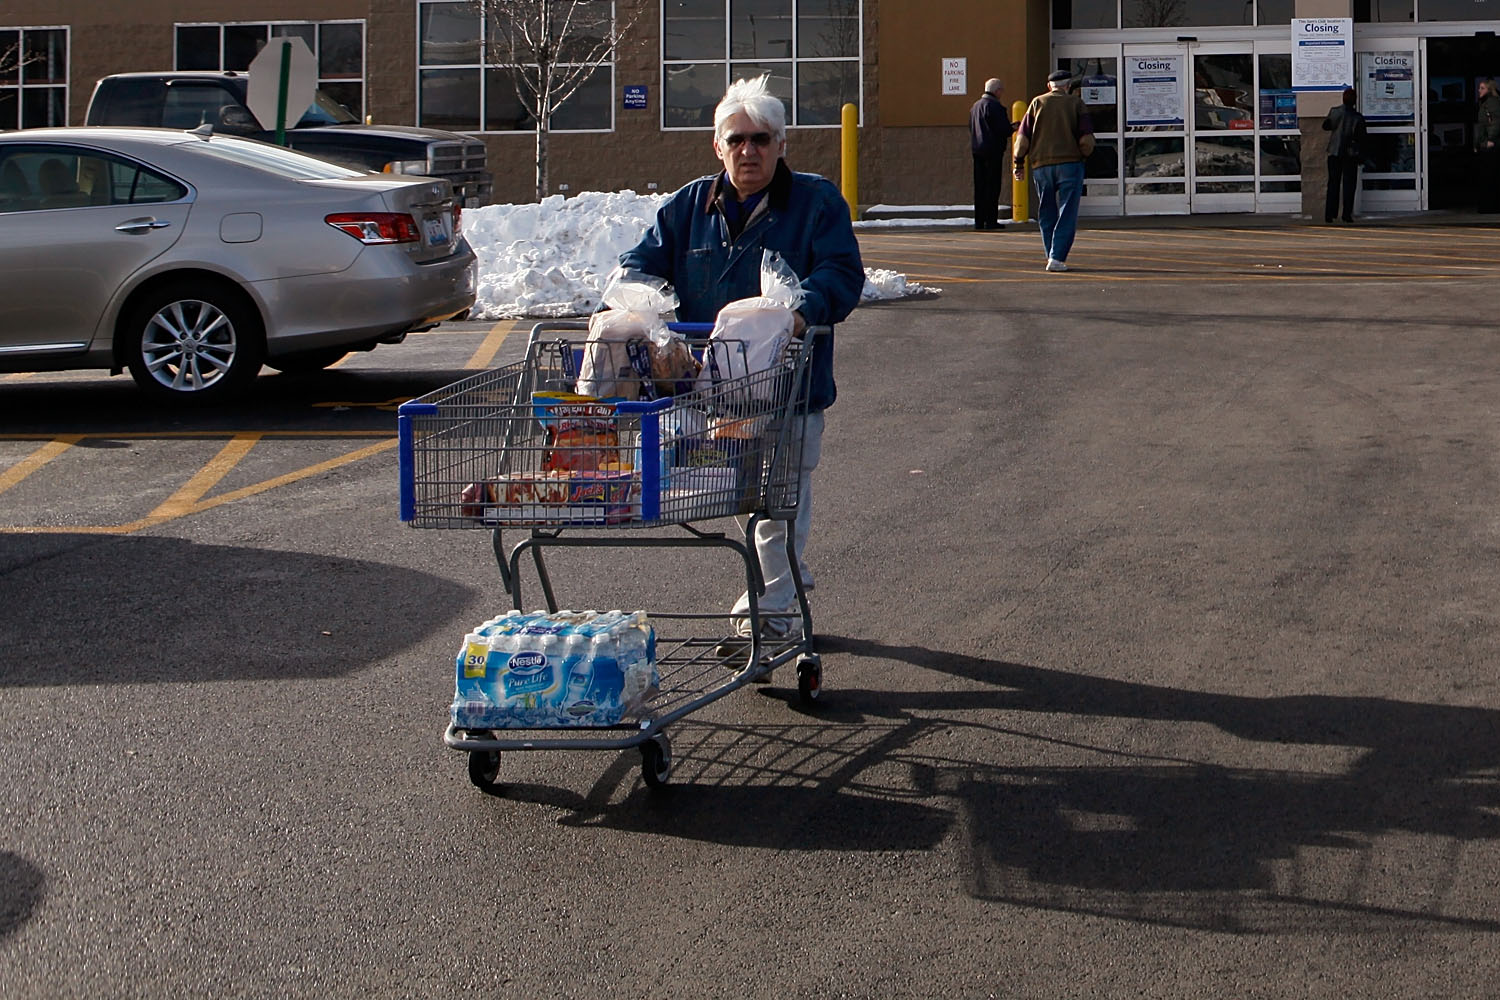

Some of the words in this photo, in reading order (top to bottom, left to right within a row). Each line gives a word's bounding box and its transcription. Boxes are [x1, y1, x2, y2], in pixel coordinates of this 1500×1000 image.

[1305, 23, 1339, 33] Closing
[1138, 61, 1171, 71] Closing
[1374, 56, 1408, 66] Closing
[467, 655, 485, 665] 30
